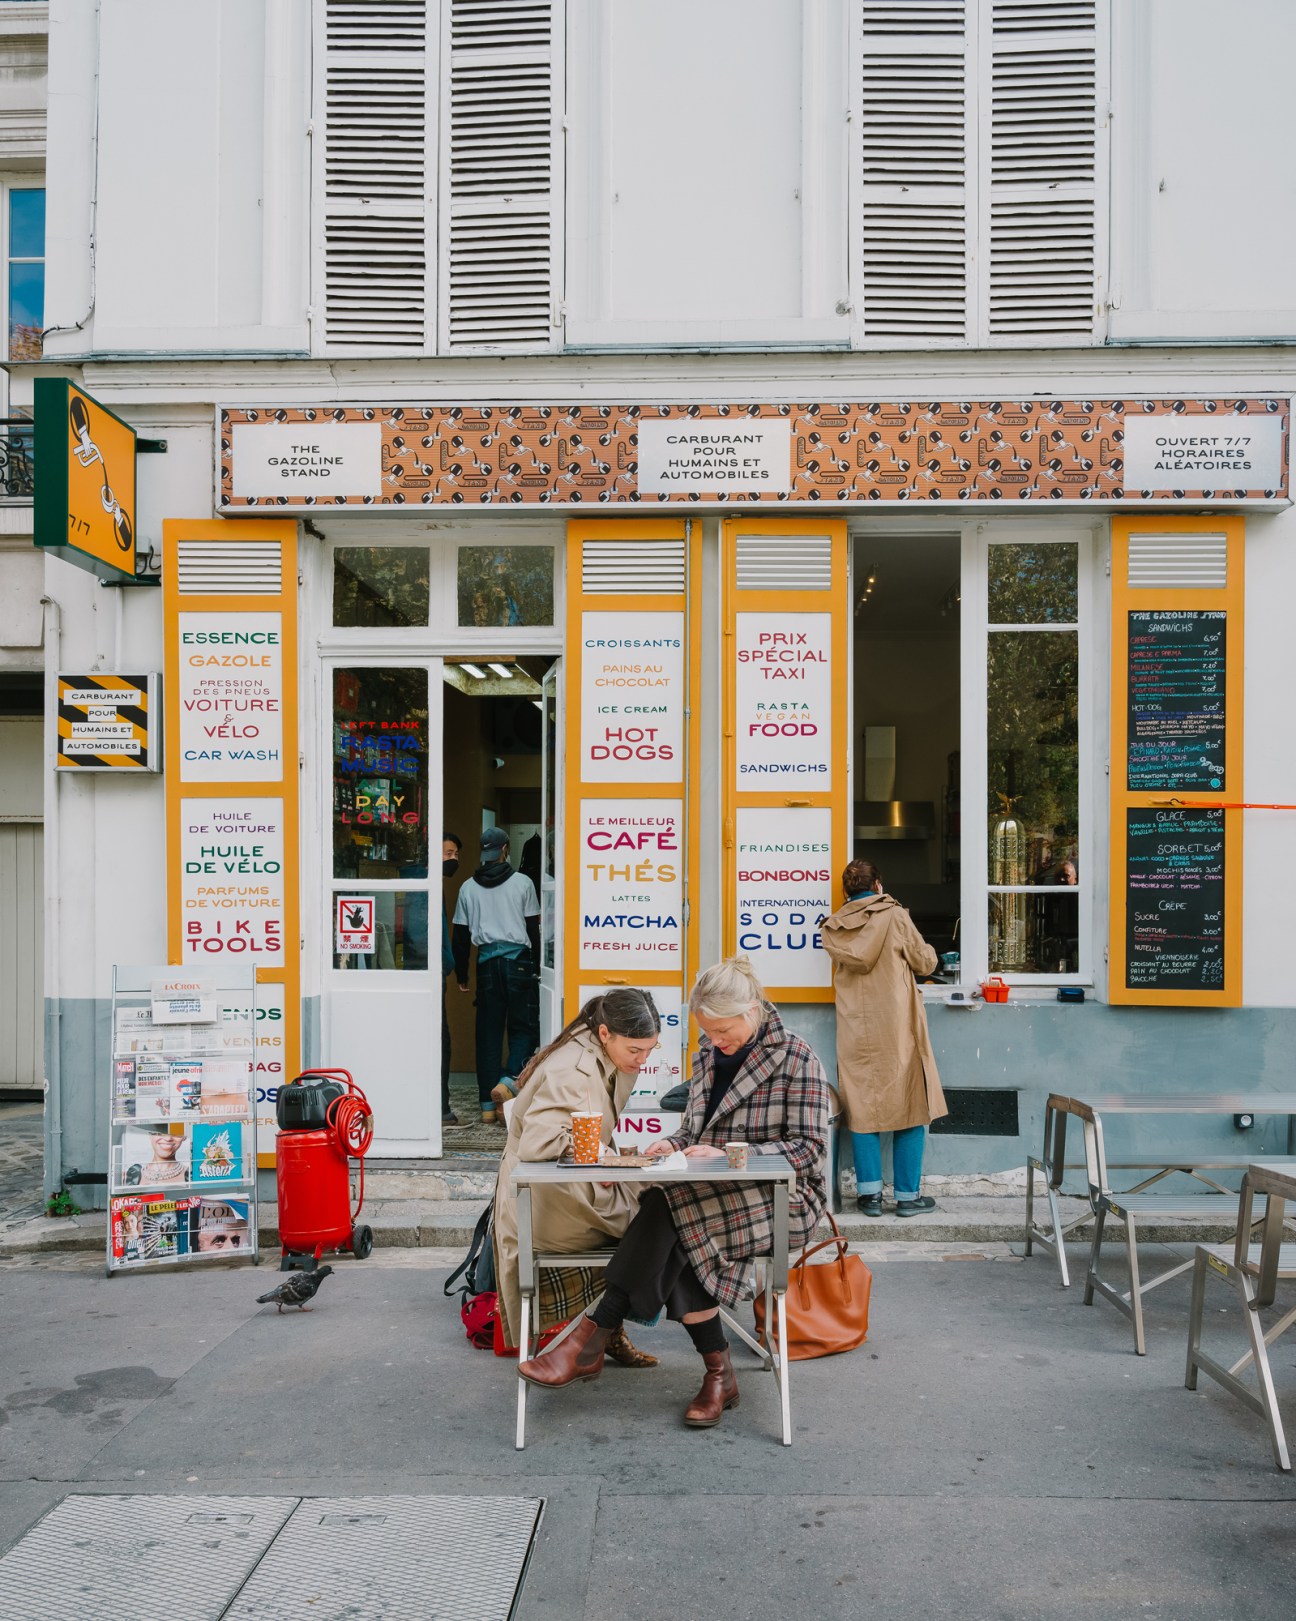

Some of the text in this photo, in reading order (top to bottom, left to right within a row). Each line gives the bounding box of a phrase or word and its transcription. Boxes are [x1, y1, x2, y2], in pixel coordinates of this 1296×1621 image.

[666, 435, 764, 445] CARBURANT
[1155, 437, 1252, 447] OUVERT 7/7
[291, 445, 320, 454] THE
[693, 447, 736, 456] POUR
[1161, 449, 1245, 458] HORAIRES
[268, 457, 344, 466] GAZOLINE
[668, 458, 761, 468] HUMAINS ET
[1154, 459, 1252, 470] ALÉATOIRES
[281, 469, 331, 477] STAND
[660, 470, 770, 480] AUTOMOBILES
[69, 513, 90, 536] 7/7
[1153, 612, 1198, 620] GAZOLINE
[1148, 623, 1194, 632] SANDWICHS
[182, 632, 280, 645] ESSENCE
[585, 639, 681, 648] CROISSANTS
[759, 633, 807, 645] PRIX
[738, 646, 828, 663] SPÉCIAL
[189, 655, 272, 667] GAZOLE
[603, 665, 663, 673] PAINS AU
[760, 667, 805, 680] TAXI
[200, 679, 263, 687] PRESSION
[595, 678, 671, 687] CHOCOLAT
[193, 688, 271, 696] DES PNEUS
[184, 699, 279, 712] VOITURE
[598, 706, 668, 714] ICE CREAM
[757, 703, 809, 711] RASTA
[756, 713, 811, 721] VEGAN
[203, 722, 260, 738] VÉLO
[341, 721, 419, 730] LEFT BANK
[749, 723, 818, 737] FOOD
[605, 727, 658, 743] HOT
[341, 735, 419, 750] RASTA
[184, 749, 279, 761] CAR WASH
[591, 745, 674, 761] DOGS
[341, 758, 419, 773] MUSIC
[740, 764, 828, 773] SANDWICHS
[358, 778, 402, 790] ALL
[356, 795, 405, 807] DAY
[213, 812, 252, 821] HUILE
[341, 812, 419, 824] LONG
[1156, 811, 1186, 822] GLACE
[589, 818, 675, 826] LE MEILLEUR
[189, 825, 276, 834] DE VOITURE
[587, 826, 678, 851] CAFÉ
[201, 845, 264, 858] HUILE
[740, 844, 829, 852] FRIANDISES
[1157, 844, 1203, 855] SORBET
[185, 858, 281, 874] DE VÉLO
[587, 858, 677, 883] THÉS
[738, 870, 830, 882] BONBONS
[197, 886, 270, 896] PARFUMS
[185, 899, 281, 908] DE VOITURE
[740, 899, 830, 907] INTERNATIONAL
[584, 915, 678, 929] MATCHA
[740, 913, 828, 926] SODA
[187, 920, 280, 935] BIKE
[187, 937, 281, 953] TOOLS
[583, 942, 679, 951] FRESH JUICE
